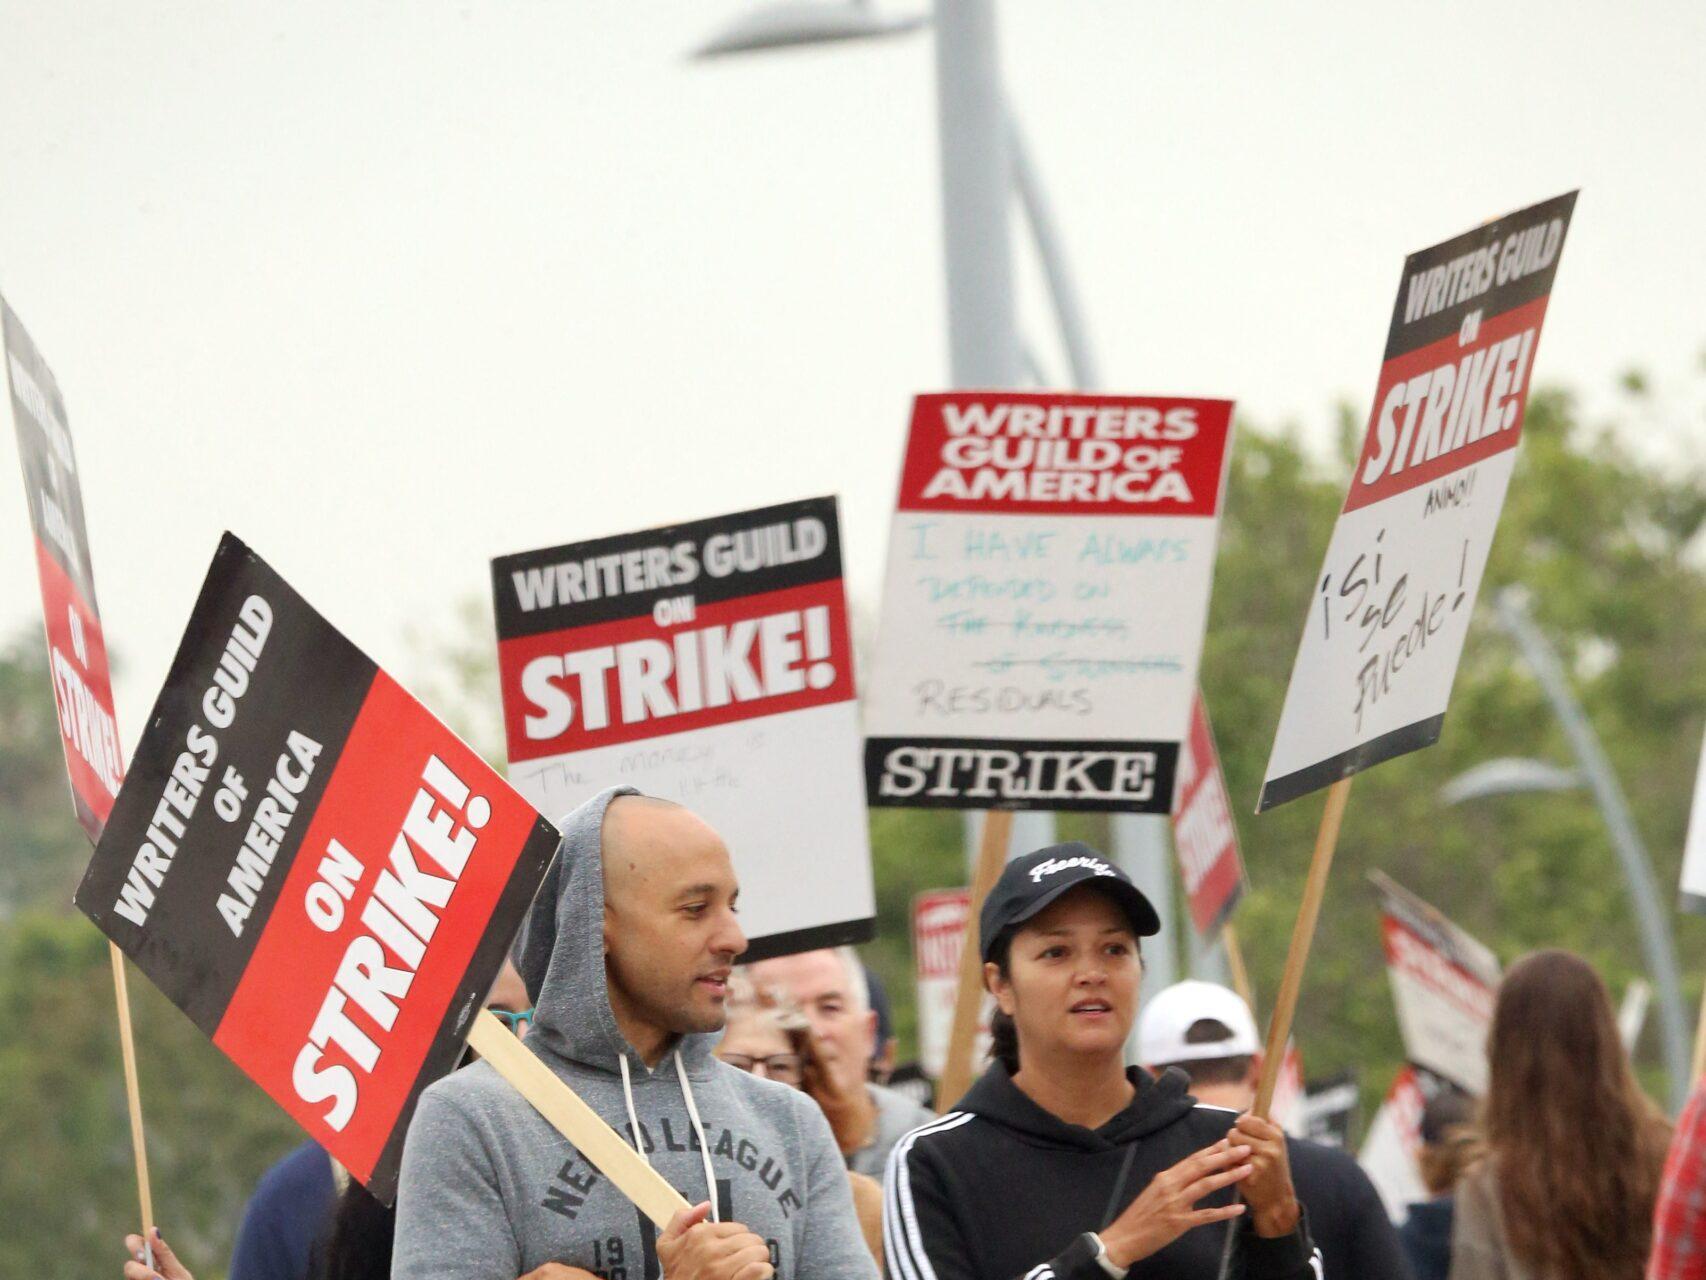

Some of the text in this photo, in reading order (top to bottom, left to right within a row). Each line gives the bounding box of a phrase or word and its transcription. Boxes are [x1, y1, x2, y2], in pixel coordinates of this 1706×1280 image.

[1404, 217, 1564, 324] WRITERS GUILD
[1458, 308, 1483, 348] ON
[940, 403, 1199, 440] WRITERS
[1361, 327, 1535, 485] STRIKE!
[921, 468, 1194, 503] AMERICA
[941, 437, 1185, 471] GUILD OF
[512, 516, 828, 612] WRITERS GUILD
[964, 529, 1056, 562] HAVE
[653, 595, 696, 628] ON
[520, 605, 837, 741] STRIKE!
[113, 724, 219, 927] WRITERS
[202, 594, 274, 729] GUILD
[213, 765, 250, 823] OF
[878, 746, 1157, 800] STRIKE
[215, 729, 323, 938] AMERICA
[304, 838, 366, 933] ON
[292, 753, 492, 1133] STRIKE!
[541, 1117, 803, 1220] NEO LEAGUE
